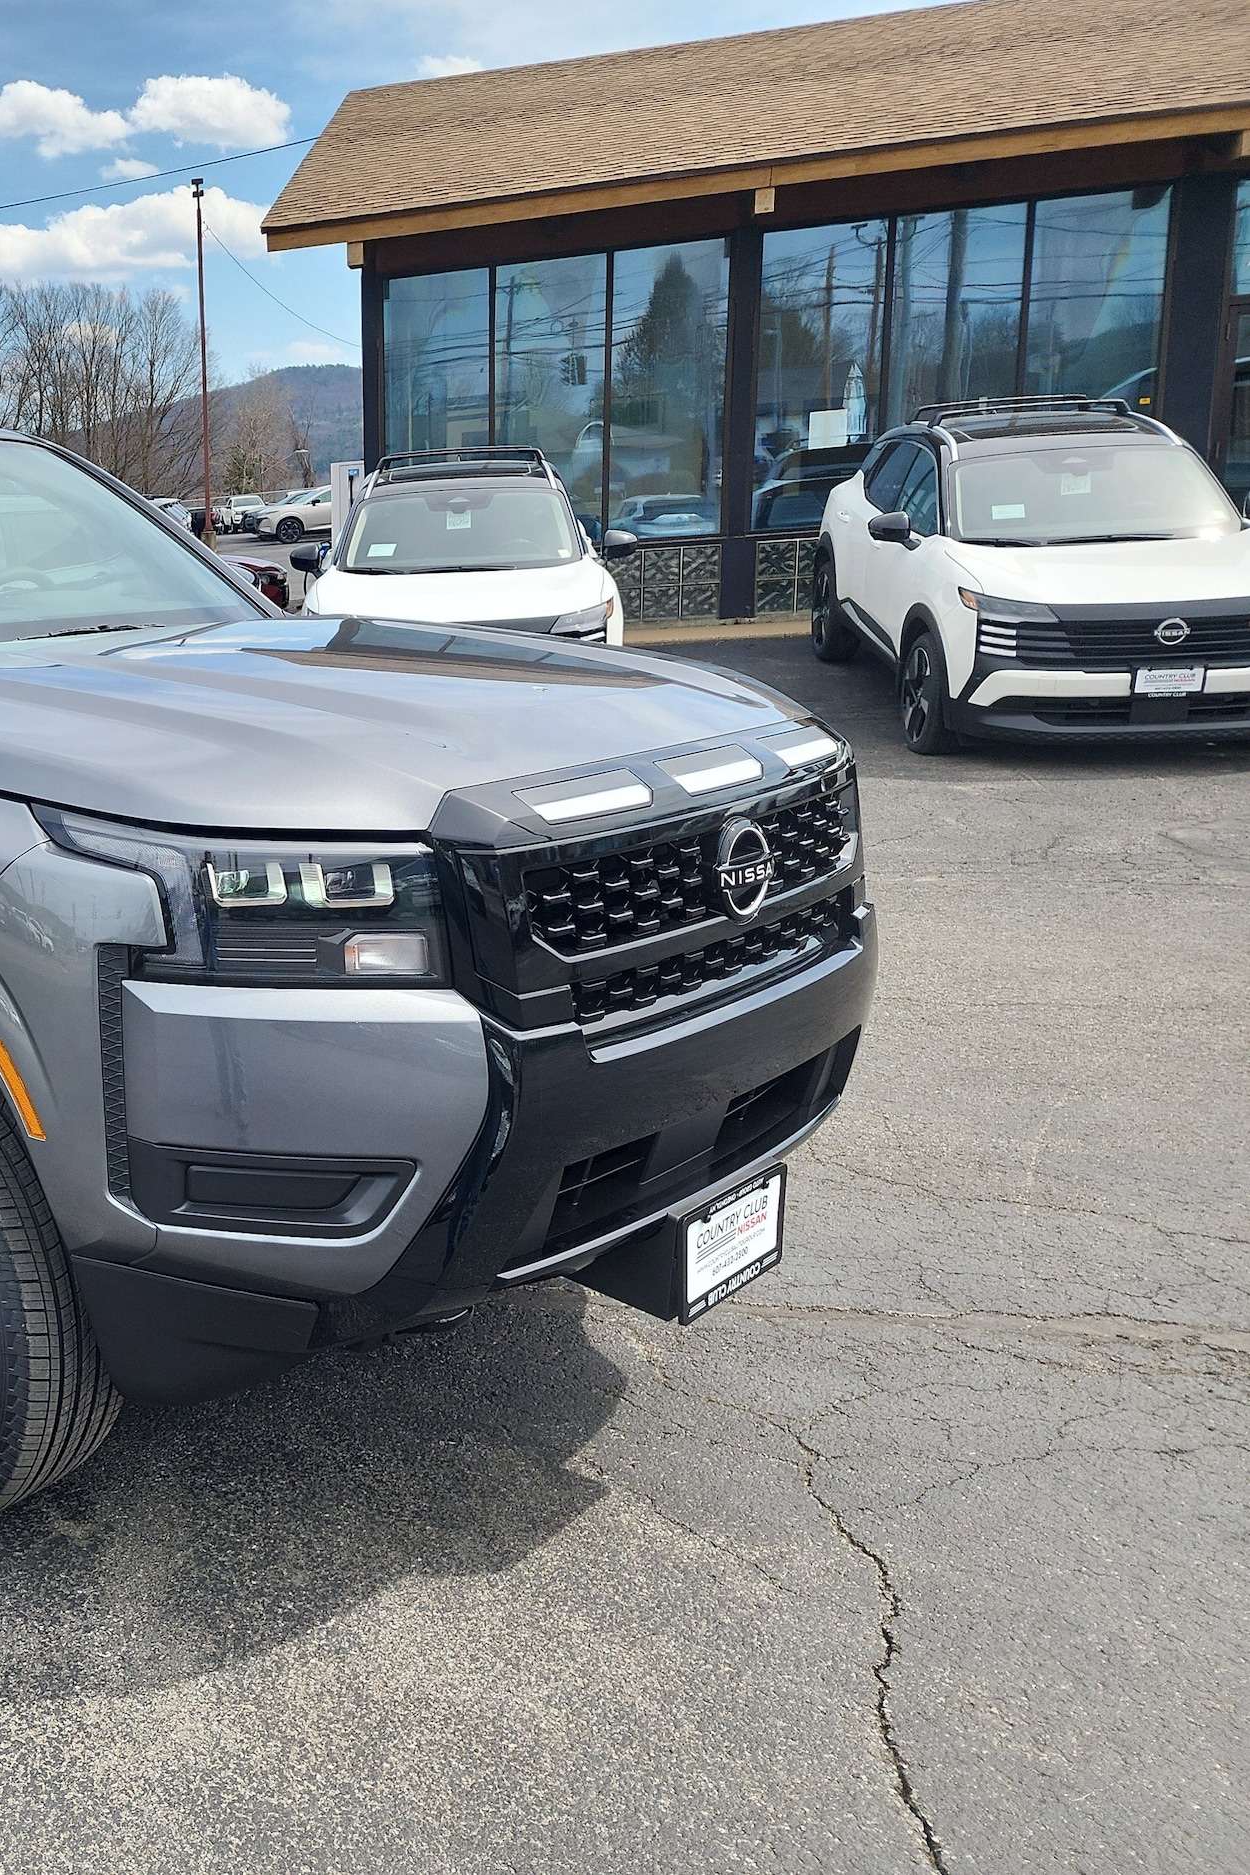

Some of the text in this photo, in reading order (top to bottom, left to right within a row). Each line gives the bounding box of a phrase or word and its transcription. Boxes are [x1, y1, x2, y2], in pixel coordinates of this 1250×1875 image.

[1153, 627, 1191, 637] NISSAN
[696, 1195, 768, 1249] COUNTRY CLUB
[736, 1211, 768, 1237] NISSAN
[707, 1261, 761, 1306] COUNTRY CLUB
